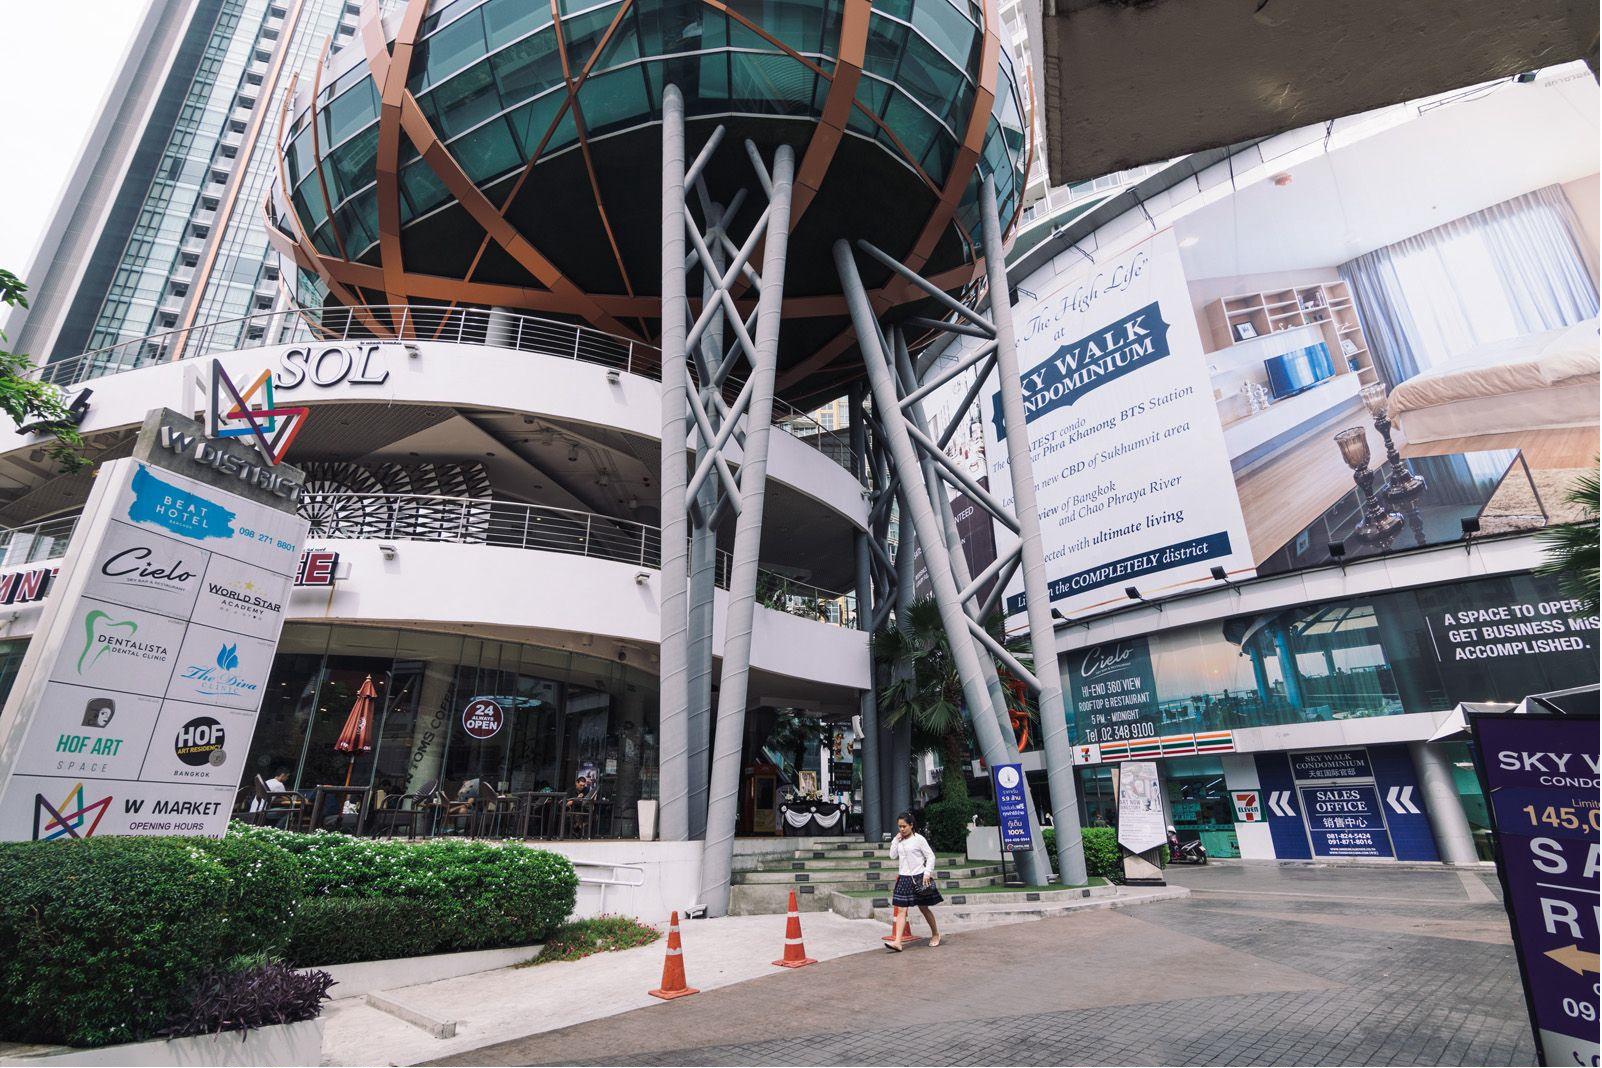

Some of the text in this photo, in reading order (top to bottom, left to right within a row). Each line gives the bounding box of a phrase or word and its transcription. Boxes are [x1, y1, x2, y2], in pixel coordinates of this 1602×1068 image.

[1024, 307, 1050, 341] The
[1055, 274, 1104, 320] High
[1053, 327, 1065, 341] at
[1021, 315, 1152, 397] KY WALK
[273, 346, 389, 389] SOL
[1023, 336, 1156, 416] NDOMINIUM
[1043, 386, 1193, 458] Phra Khanong BTS Station
[1059, 418, 1086, 438] condo
[161, 426, 299, 500] W DISTRICT
[1041, 422, 1190, 488] new CBD of Sukhumvit area
[993, 460, 1006, 473] The
[164, 496, 208, 516] BEAT
[1058, 475, 1182, 527] and Chao Phraya River
[1061, 497, 1071, 513] of
[1073, 481, 1116, 507] Bangkok
[156, 505, 208, 528] HOTEL
[239, 527, 295, 551] 098 271 8801
[1068, 535, 1090, 553] with
[1093, 521, 1142, 546] ultimate
[1146, 509, 1184, 528] living
[102, 547, 197, 581] Cielo
[1055, 542, 1209, 595] the COMPLETELY district
[209, 583, 281, 612] WORLD STAR
[222, 600, 264, 615] ACADEMY
[1444, 613, 1456, 626] A
[1458, 607, 1511, 624] SPACE
[1511, 603, 1535, 618] TO
[1449, 628, 1477, 642] GET
[1482, 620, 1565, 640] BUSINESS
[98, 634, 167, 655] DENTALISTA
[112, 647, 166, 661] DENTAL CLINIC
[1455, 637, 1591, 660] ACCOMPLISHED.
[1081, 643, 1134, 677] Cielo
[181, 666, 257, 691] The Diva
[1081, 676, 1141, 698] HI-END VIEW
[475, 705, 494, 716] 24
[1078, 692, 1150, 712] ROOFTOP & RESTAURANT
[466, 720, 497, 730] OPEN
[1091, 714, 1096, 725] 5
[1111, 709, 1140, 722] MIDNIGHT
[177, 725, 225, 748] HOF
[1114, 724, 1130, 740] 348
[1133, 722, 1155, 737] 9100
[56, 734, 123, 756] HOF ART
[177, 744, 222, 755] ART RESIDENCY
[57, 761, 107, 773] SPACE
[1296, 760, 1365, 769] CONDOMINIUM
[1324, 753, 1352, 761] WALK
[1498, 750, 1571, 774] SKY
[1316, 790, 1360, 801] SALES
[1316, 801, 1367, 812] OFFICE
[124, 799, 221, 815] W MARKET
[129, 822, 204, 830] OPENING HOURS
[1323, 817, 1368, 828] 销售中心
